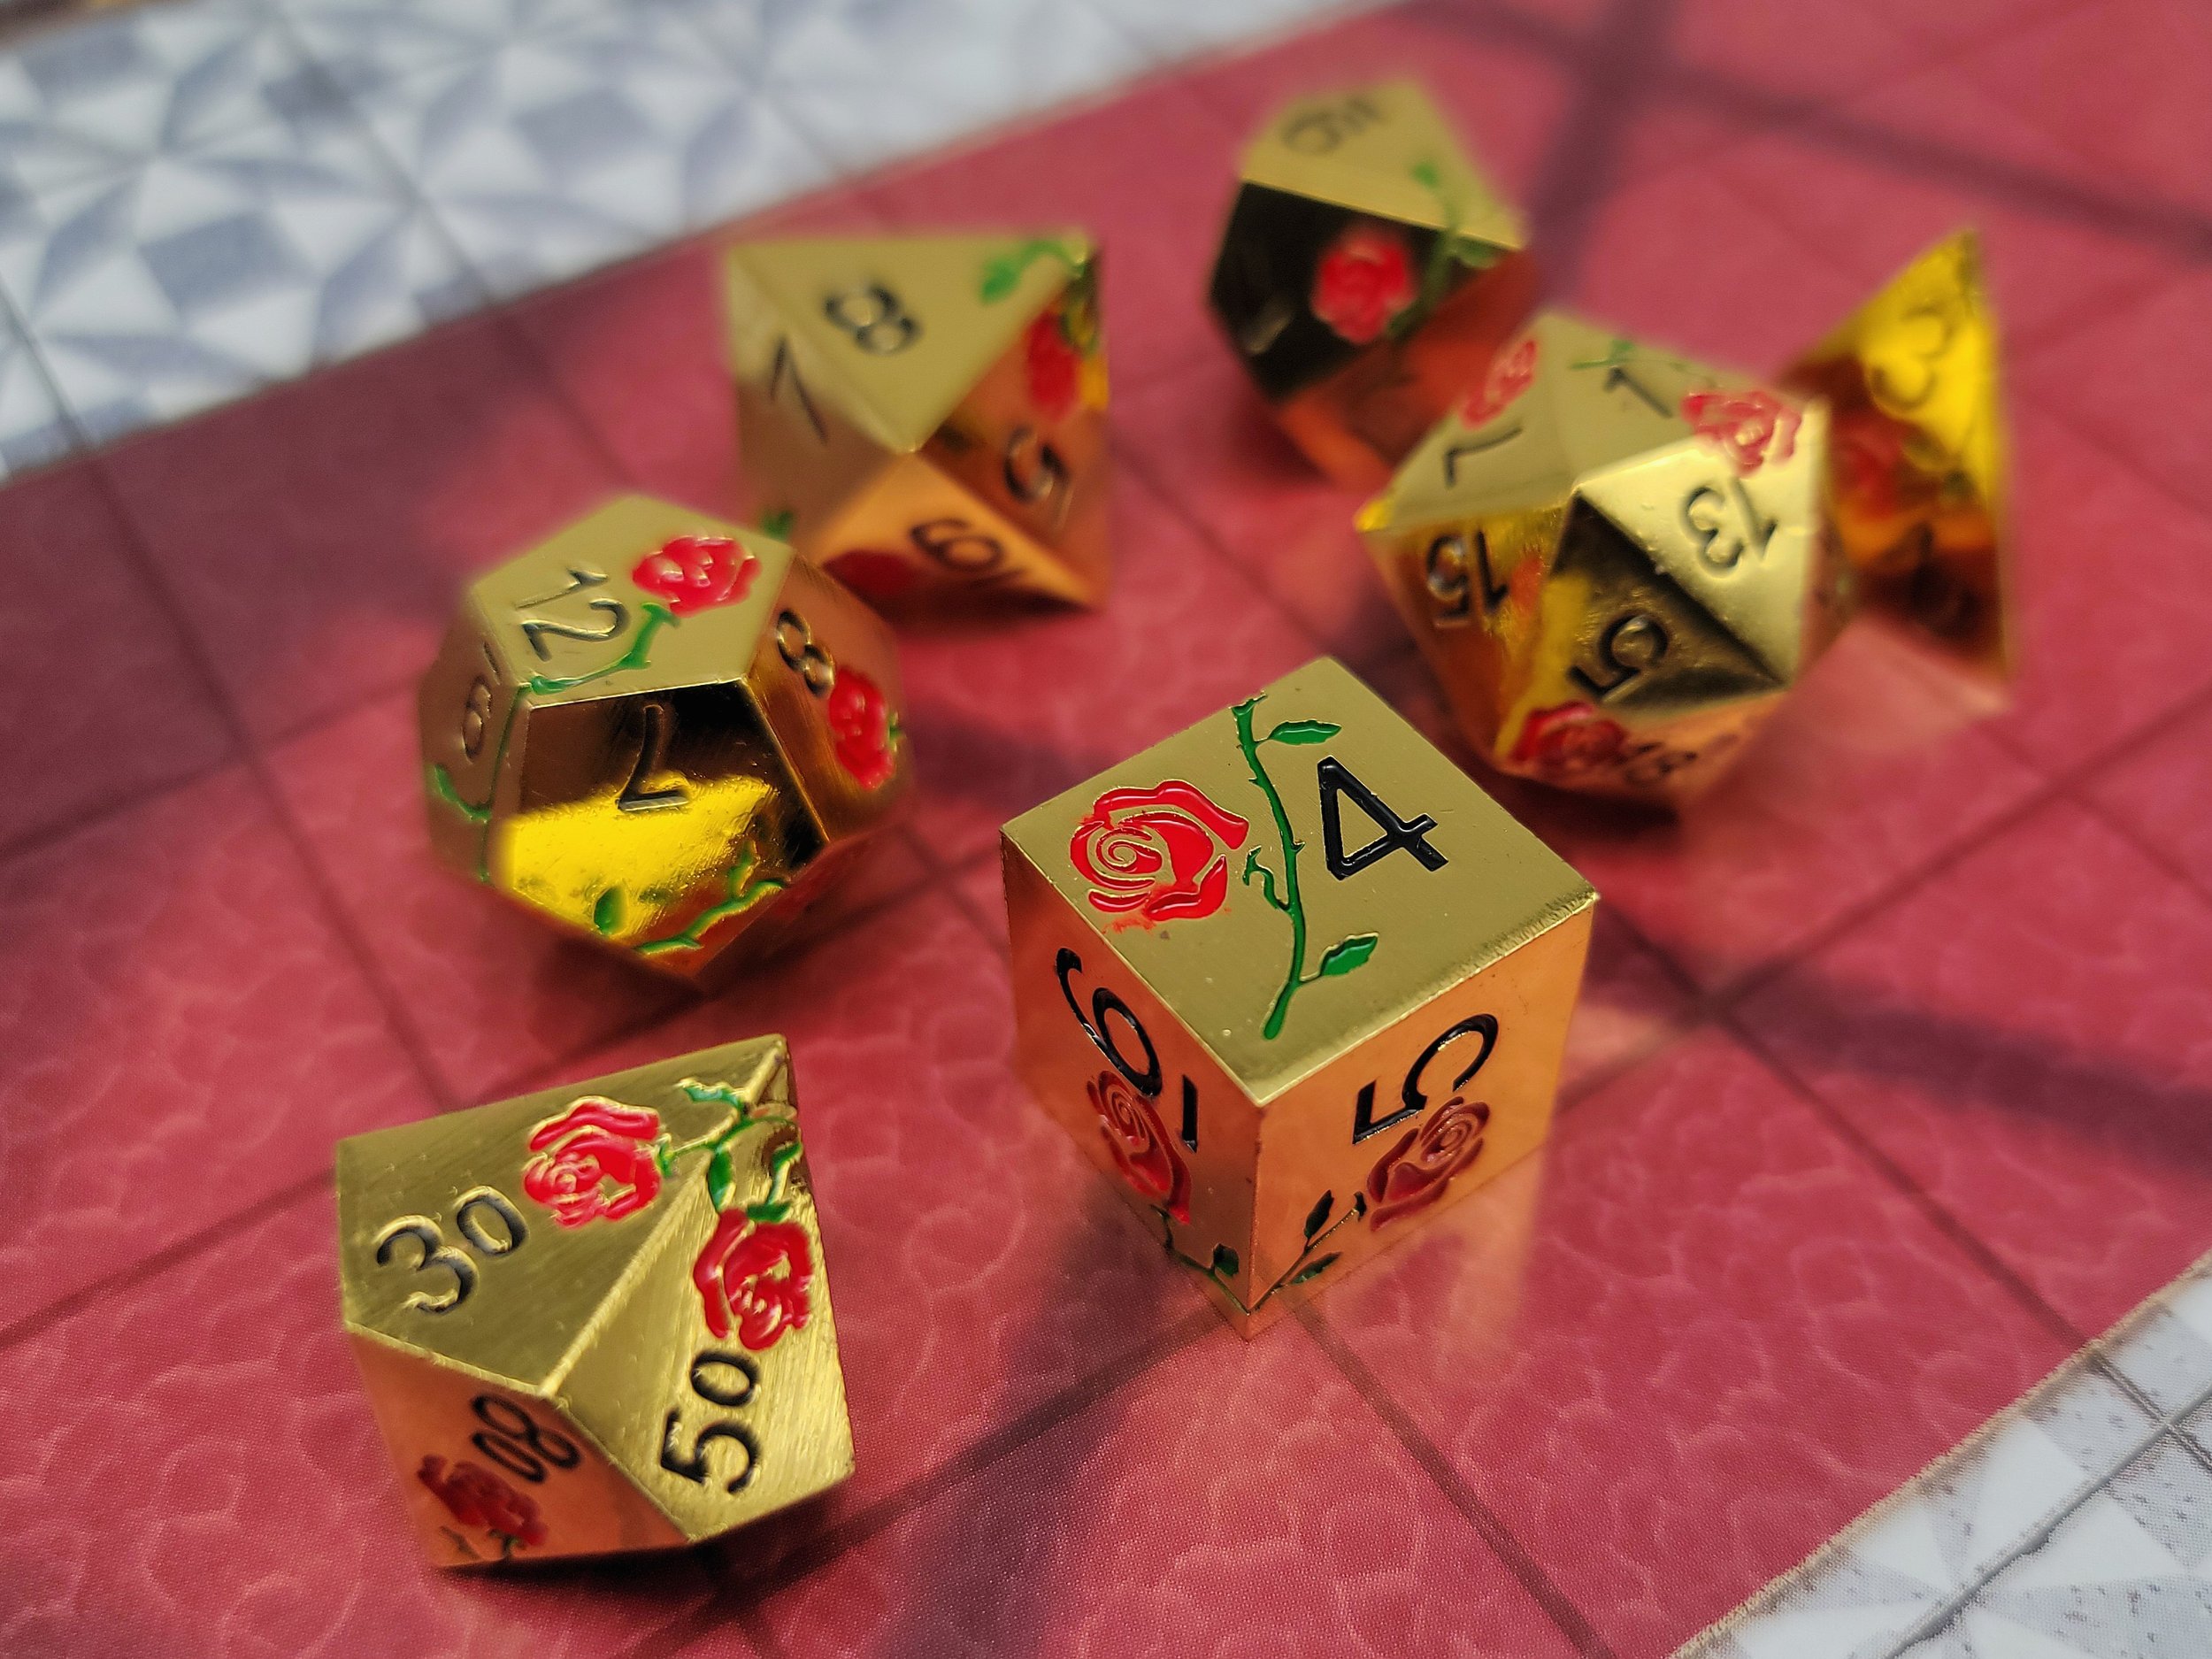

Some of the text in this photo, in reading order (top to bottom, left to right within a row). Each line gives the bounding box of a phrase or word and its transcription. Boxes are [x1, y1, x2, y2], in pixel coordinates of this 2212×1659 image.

[823, 279, 922, 355] 8
[1425, 527, 1509, 628] 15
[1683, 479, 1778, 579] 13
[512, 562, 629, 662] 12
[776, 609, 837, 699] 8
[1567, 613, 1670, 702] 5
[1317, 756, 1449, 881] 4
[1351, 1013, 1500, 1146] 5
[375, 1185, 529, 1316] 30
[660, 1349, 762, 1495] 50
